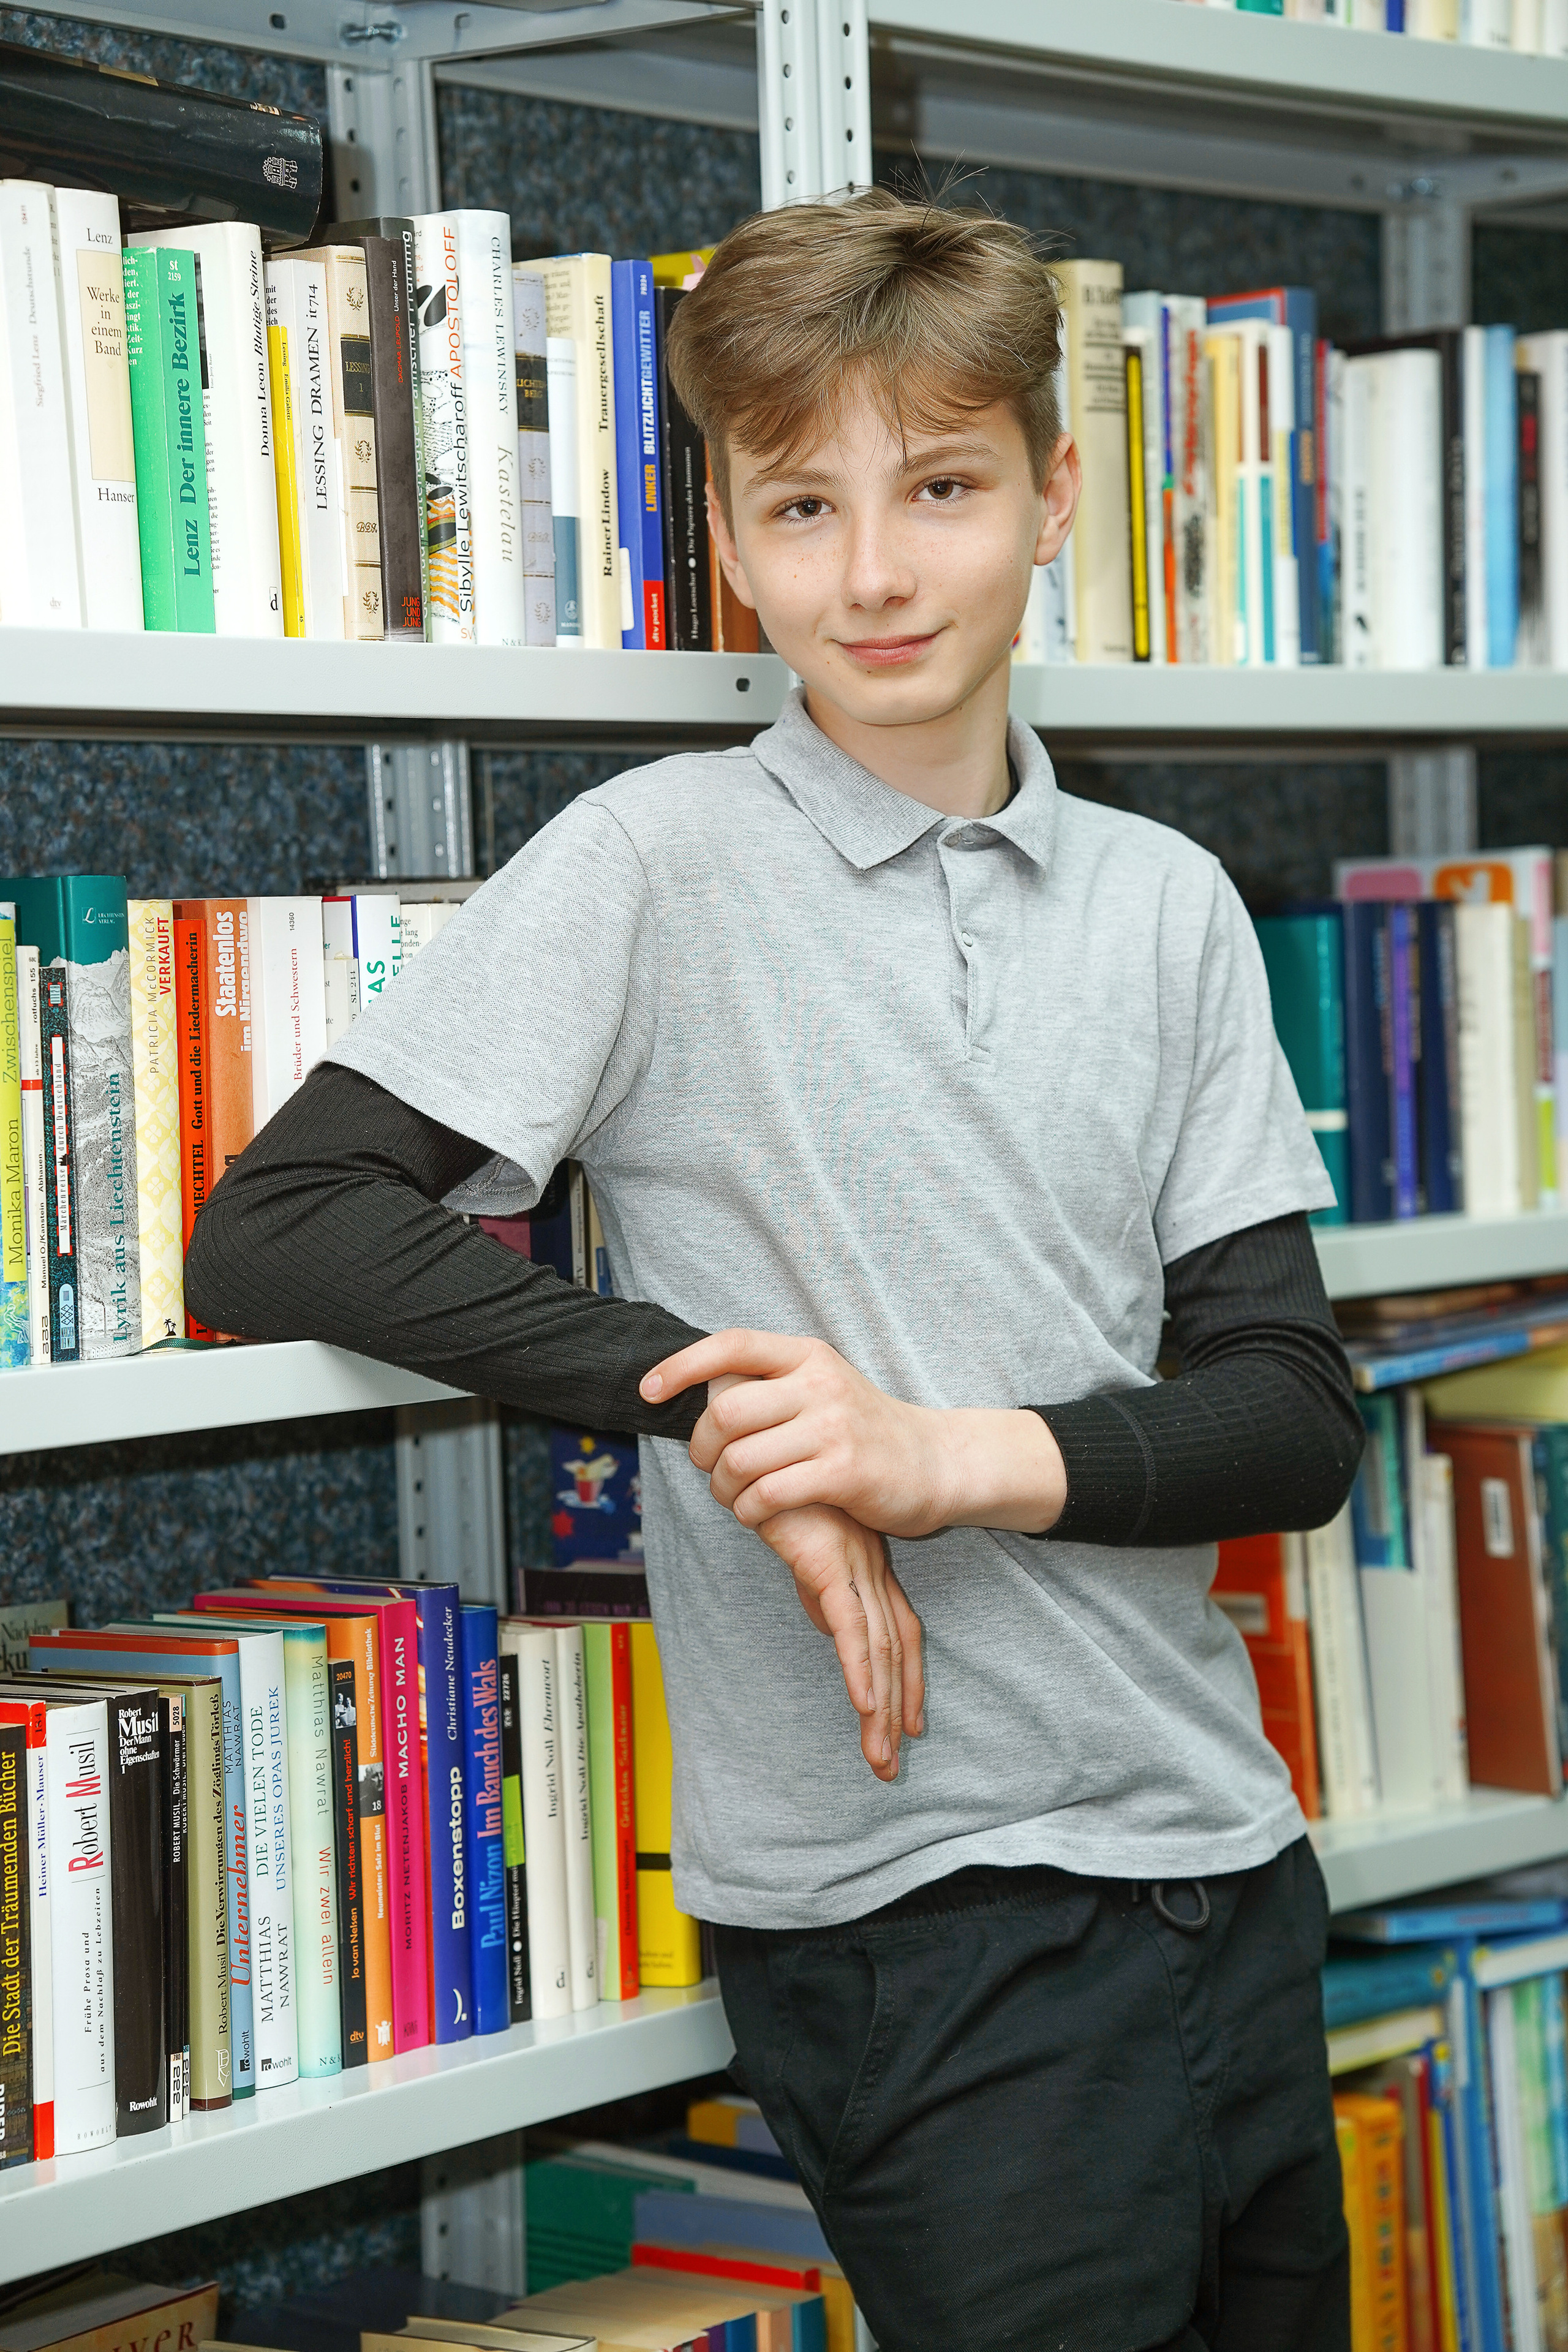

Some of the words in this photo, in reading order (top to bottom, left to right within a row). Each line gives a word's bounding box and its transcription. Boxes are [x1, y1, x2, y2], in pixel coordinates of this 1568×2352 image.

[86, 228, 113, 244] Lenz
[168, 272, 181, 282] 2159
[169, 259, 178, 271] st
[250, 251, 260, 300] Steine
[491, 236, 503, 317] CHARLES
[86, 286, 120, 303] Werke
[100, 306, 110, 320] in
[444, 227, 462, 378] APOSTOLOFF
[91, 322, 123, 337] einem
[94, 341, 121, 356] Band
[168, 292, 189, 372] Bezirk
[253, 302, 263, 356] Blutige
[258, 363, 266, 401] Leon
[496, 325, 508, 414] LEWINSKY
[595, 295, 609, 432] Trauergesellschaft
[639, 310, 656, 454] BLITZLICHTGEWITTER
[176, 378, 194, 453] innere
[261, 406, 270, 458] Donna
[179, 457, 197, 505] Der
[451, 383, 467, 533] Lewitscharoff
[98, 488, 135, 503] Hanser
[498, 445, 515, 562] Kastelau
[601, 469, 610, 524] Lindow
[644, 464, 657, 511] LINKER
[687, 505, 696, 537] Papiere
[184, 518, 201, 577] Lenz
[603, 525, 612, 576] Rainer
[457, 539, 472, 612] Sibylle
[402, 597, 420, 606] JUNG
[402, 617, 421, 627] JUNG
[407, 607, 420, 616] UND
[650, 594, 660, 625] pocket
[651, 628, 660, 643] dtv
[690, 614, 699, 639] Hugo
[145, 917, 157, 1002] McCORMICK
[157, 917, 171, 995] VERKAUFT
[213, 911, 237, 1017] Staatenlos
[290, 948, 300, 1012] Schwestern
[0, 937, 17, 1084] Zwischenspiel
[185, 932, 201, 1041] Liedermacherin
[146, 1009, 159, 1073] PATRICIA
[292, 1016, 300, 1040] und
[189, 1046, 201, 1067] die
[293, 1041, 302, 1080] Brüder
[190, 1069, 202, 1096] und
[191, 1100, 203, 1129] Gott
[6, 1119, 20, 1181] Maron
[108, 1073, 124, 1226] Liechtenstein
[192, 1140, 205, 1215] MECHTEL
[7, 1183, 23, 1265] Monika
[115, 1235, 126, 1275] aus
[111, 1279, 131, 1343] Lyrik
[394, 1637, 406, 1686] MAN
[442, 1607, 455, 1671] Neudecker
[312, 1655, 326, 1738] Matthias
[336, 1671, 352, 1681] 20470
[471, 1659, 497, 1708] Wals
[502, 1673, 510, 1701] 22726
[542, 1659, 553, 1731] Ehrenwort
[118, 1712, 159, 1738] Musil
[119, 1707, 141, 1719] Robert
[209, 1694, 220, 1737] Törleß
[269, 1686, 282, 1745] JUREK
[445, 1675, 457, 1741] Christiane
[474, 1708, 499, 1736] des
[119, 1736, 134, 1747] Der
[134, 1735, 151, 1745] Mann
[119, 1746, 138, 1756] ohne
[223, 1700, 233, 1774] MATTHIAS
[233, 1706, 242, 1766] NAWRAT
[251, 1706, 264, 1760] TODE
[396, 1695, 409, 1777] MACHO
[545, 1740, 554, 1768] Noll
[36, 1755, 45, 1801] Mauser
[66, 1740, 101, 1798] Musil
[120, 1749, 160, 1766] Eigenschaften
[172, 1740, 180, 1782] Schwärmer
[211, 1740, 221, 1798] Zöglings
[272, 1751, 283, 1798] OPAS
[344, 1738, 353, 1781] herzlich!
[474, 1741, 500, 1806] Bauch
[0, 1752, 17, 1812] Bücher
[254, 1766, 267, 1838] VIELEN
[315, 1749, 330, 1815] Nawrat
[344, 1782, 354, 1805] und
[372, 1800, 381, 1811] 18
[546, 1773, 558, 1817] Ingrid
[37, 1808, 46, 1850] Müller
[213, 1801, 222, 1823] des
[346, 1807, 355, 1843] scharf
[400, 1784, 411, 1885] NETENJAKOB
[477, 1806, 502, 1839] Im
[69, 1803, 104, 1872] Robert
[257, 1843, 269, 1877] DIE
[274, 1804, 285, 1891] UNSERES
[318, 1846, 332, 1876] Wir
[449, 1766, 466, 1929] Boxenstopp
[0, 1817, 19, 1935] Träumenden
[39, 1853, 47, 1898] Heiner
[215, 1826, 226, 1923] Verwirrungen
[347, 1845, 356, 1880] richten
[478, 1843, 505, 1901] Nizon
[227, 1805, 251, 1986] Unternehmer
[320, 1887, 334, 1925] zwei
[216, 1927, 225, 1947] Die
[350, 1907, 359, 1947] Nelsen
[403, 1891, 412, 1950] MORITZ
[479, 1902, 505, 1949] Paul
[6, 1939, 19, 1967] der
[97, 1951, 102, 1964] zu
[217, 1954, 226, 1988] Musil
[258, 1916, 274, 2024] MATTHIAS
[277, 1923, 290, 2008] NAWRAT
[322, 1934, 336, 1985] allein
[1, 1971, 20, 2022] Stadt
[96, 1967, 105, 2017] Nachlaß
[218, 1990, 228, 2035] Robert
[3, 2022, 21, 2056] Die
[129, 2096, 157, 2112] Rowohlt
